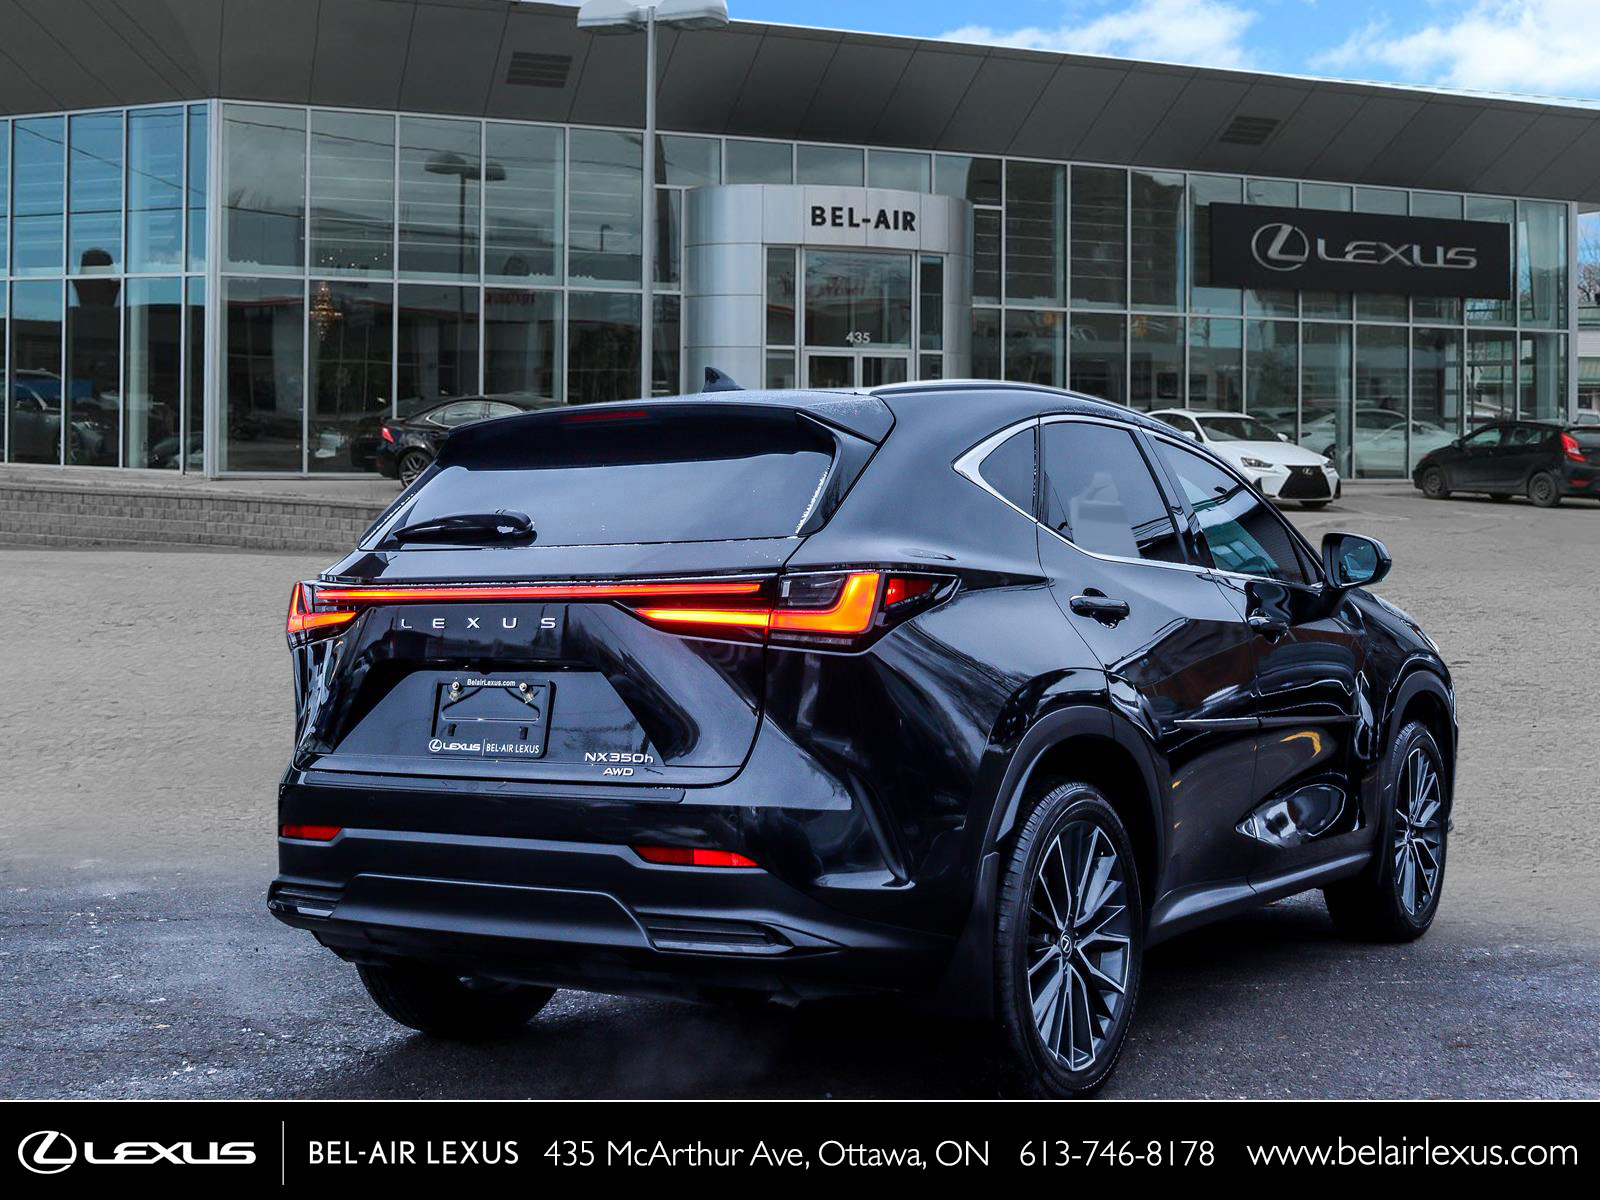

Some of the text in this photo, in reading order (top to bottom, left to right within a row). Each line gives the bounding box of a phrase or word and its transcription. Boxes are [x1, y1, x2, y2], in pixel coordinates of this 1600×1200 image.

[811, 205, 916, 232] BEL-AIR
[1316, 237, 1478, 270] LEXUS
[846, 331, 871, 344] 435
[401, 617, 556, 629] LEXUS
[467, 678, 516, 687] BelairLexus.com
[443, 742, 481, 752] LEXUS
[515, 744, 540, 754] LEXUS
[584, 752, 654, 763] NX350h
[603, 767, 634, 776] AWD
